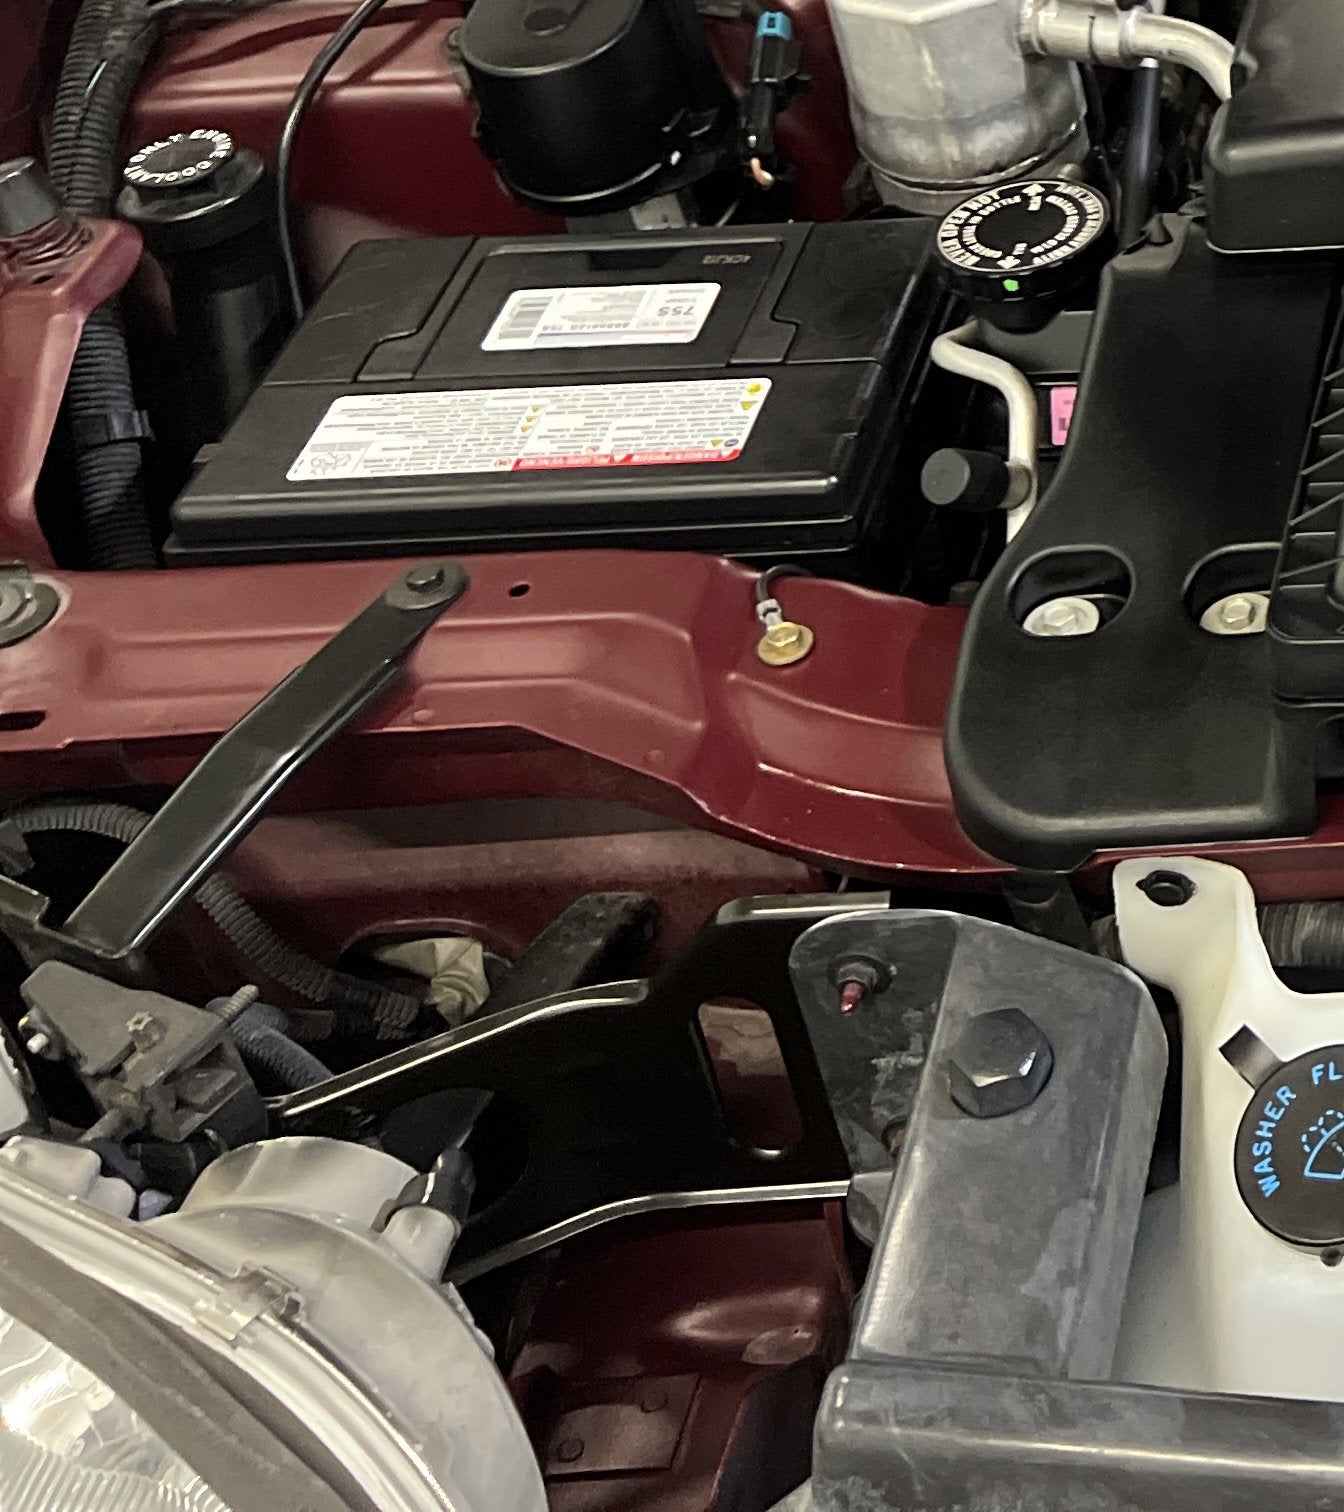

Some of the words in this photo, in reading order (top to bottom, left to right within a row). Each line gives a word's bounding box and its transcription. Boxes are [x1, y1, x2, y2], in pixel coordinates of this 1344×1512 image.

[124, 160, 212, 183] COOLANT
[964, 191, 1000, 210] HOT
[1252, 1085, 1297, 1198] WASHER
